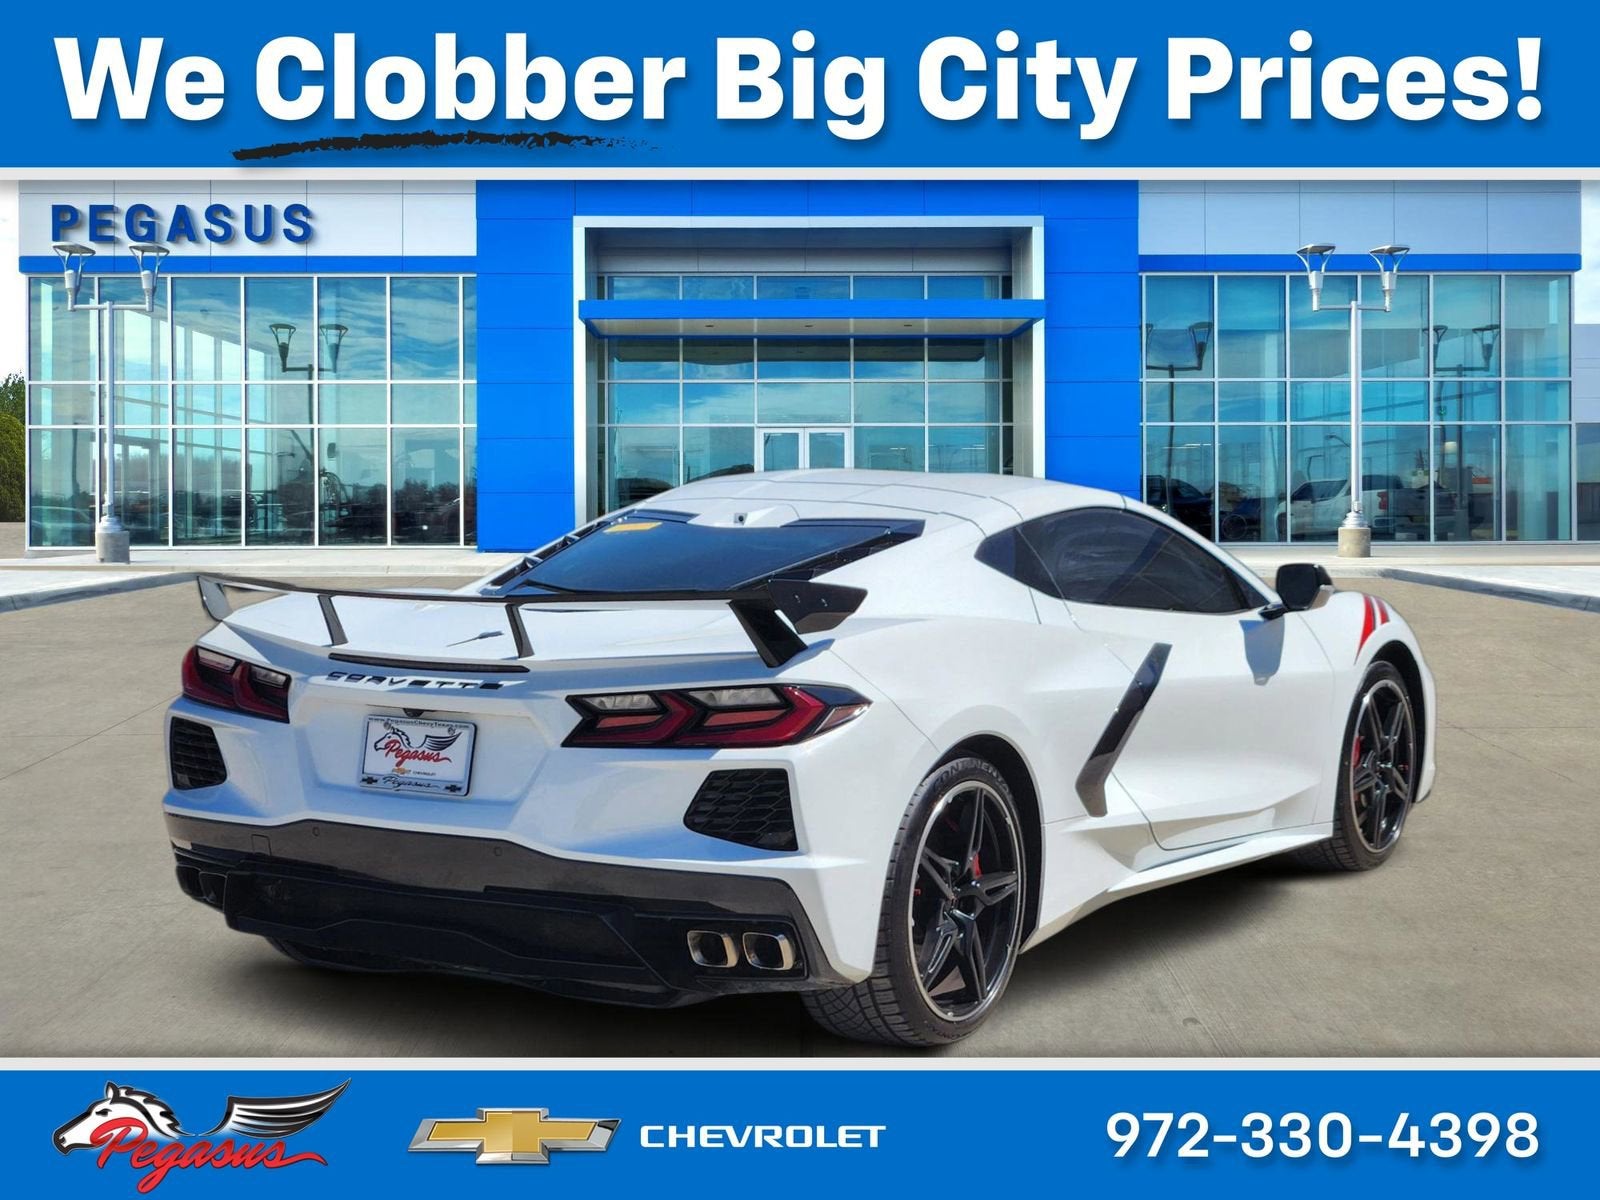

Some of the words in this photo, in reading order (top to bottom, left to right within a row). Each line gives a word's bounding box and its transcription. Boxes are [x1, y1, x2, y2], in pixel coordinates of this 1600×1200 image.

[51, 203, 314, 244] PEGASUS
[327, 671, 504, 690] CORVETTE
[384, 739, 452, 768] Pegasus
